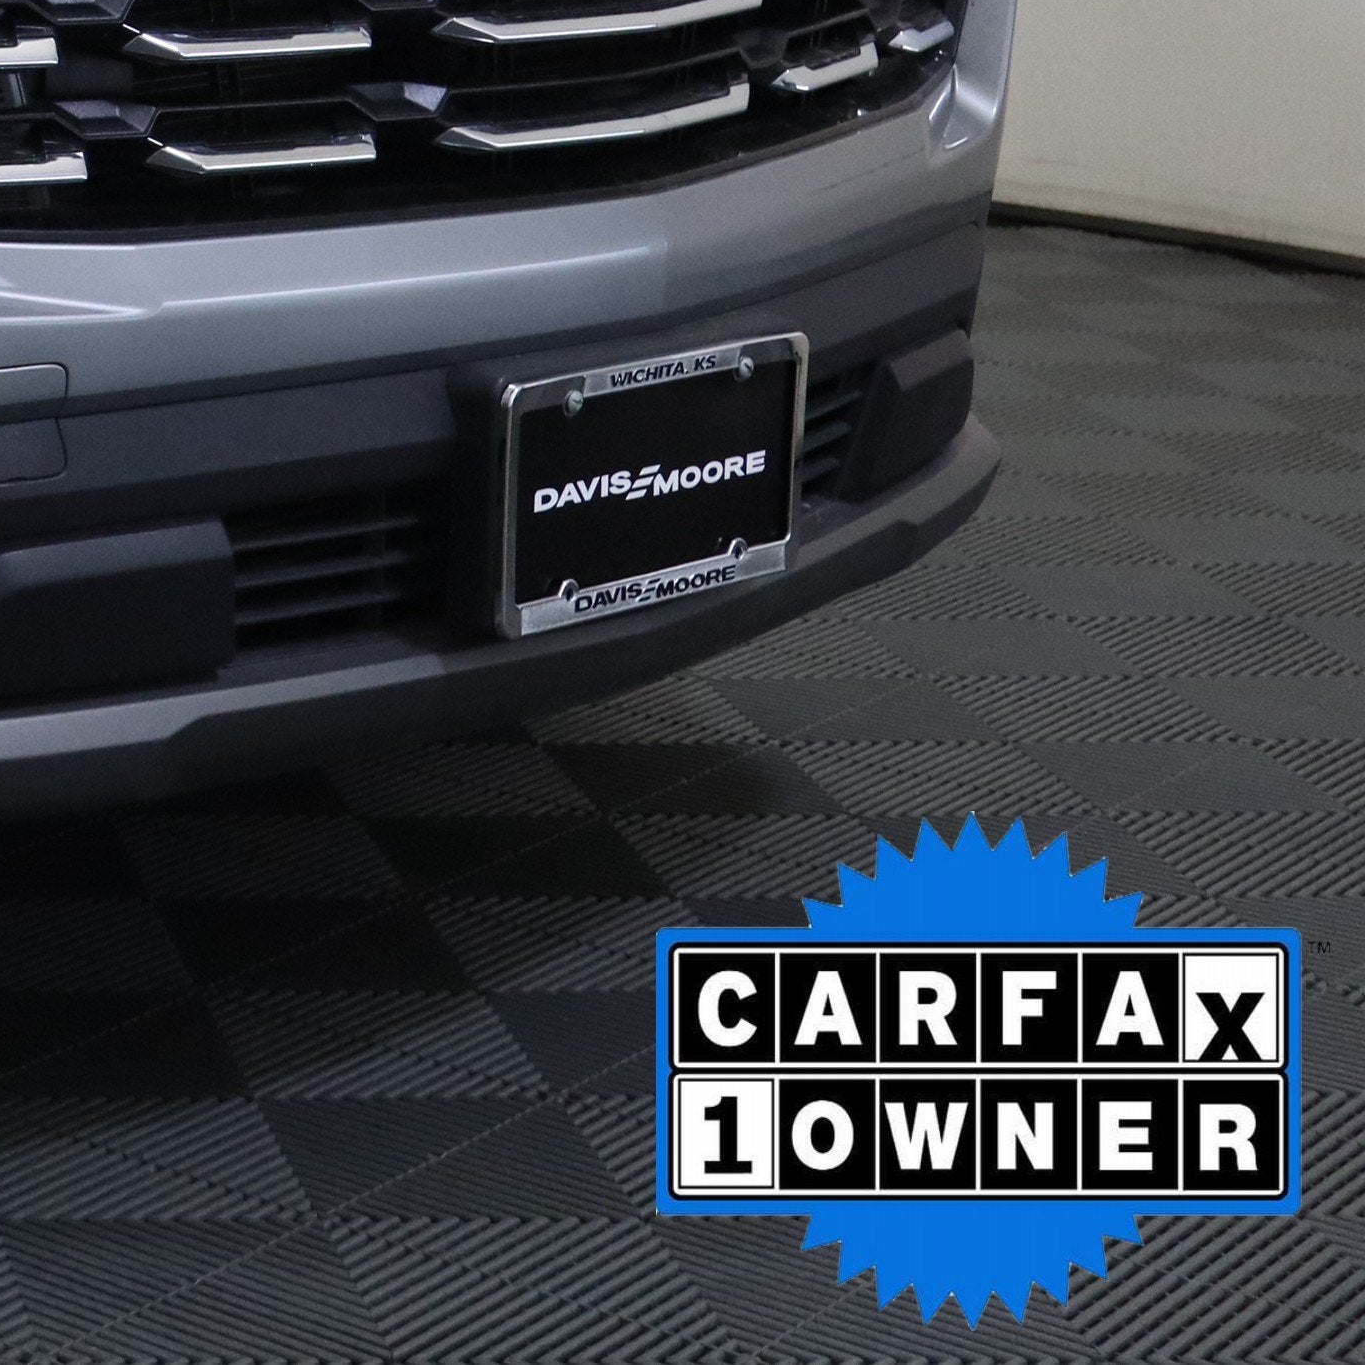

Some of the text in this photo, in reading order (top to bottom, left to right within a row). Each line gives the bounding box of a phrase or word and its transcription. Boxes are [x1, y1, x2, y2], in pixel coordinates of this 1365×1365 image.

[694, 355, 716, 372] KS
[533, 449, 766, 513] DAVIS MOORE
[575, 564, 737, 613] DAVIS MOORE
